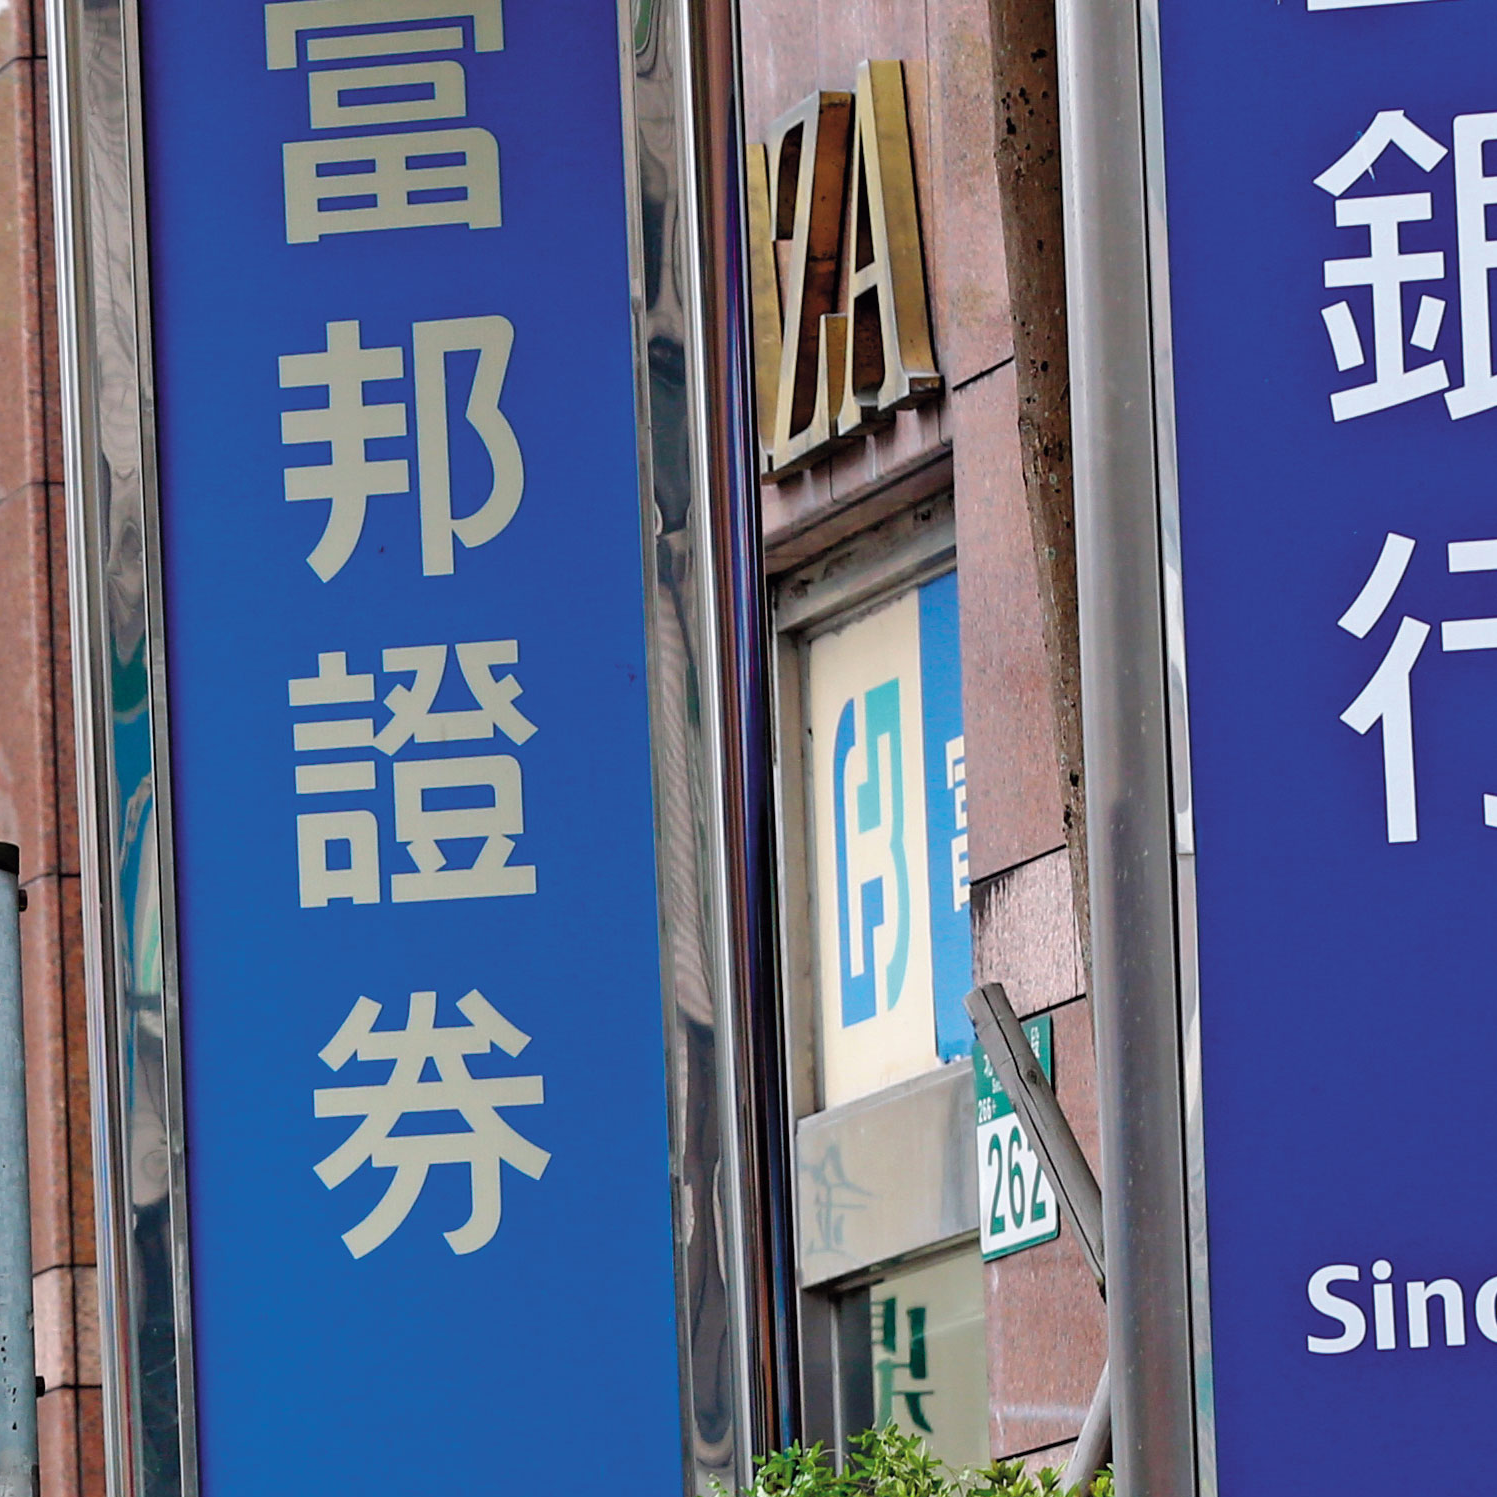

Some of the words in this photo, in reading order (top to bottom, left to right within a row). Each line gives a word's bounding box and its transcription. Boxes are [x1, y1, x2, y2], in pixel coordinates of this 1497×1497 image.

[263, 0, 551, 1260] 富邦證券
[1308, 0, 1497, 844] 銀行
[987, 1126, 1047, 1238] 262
